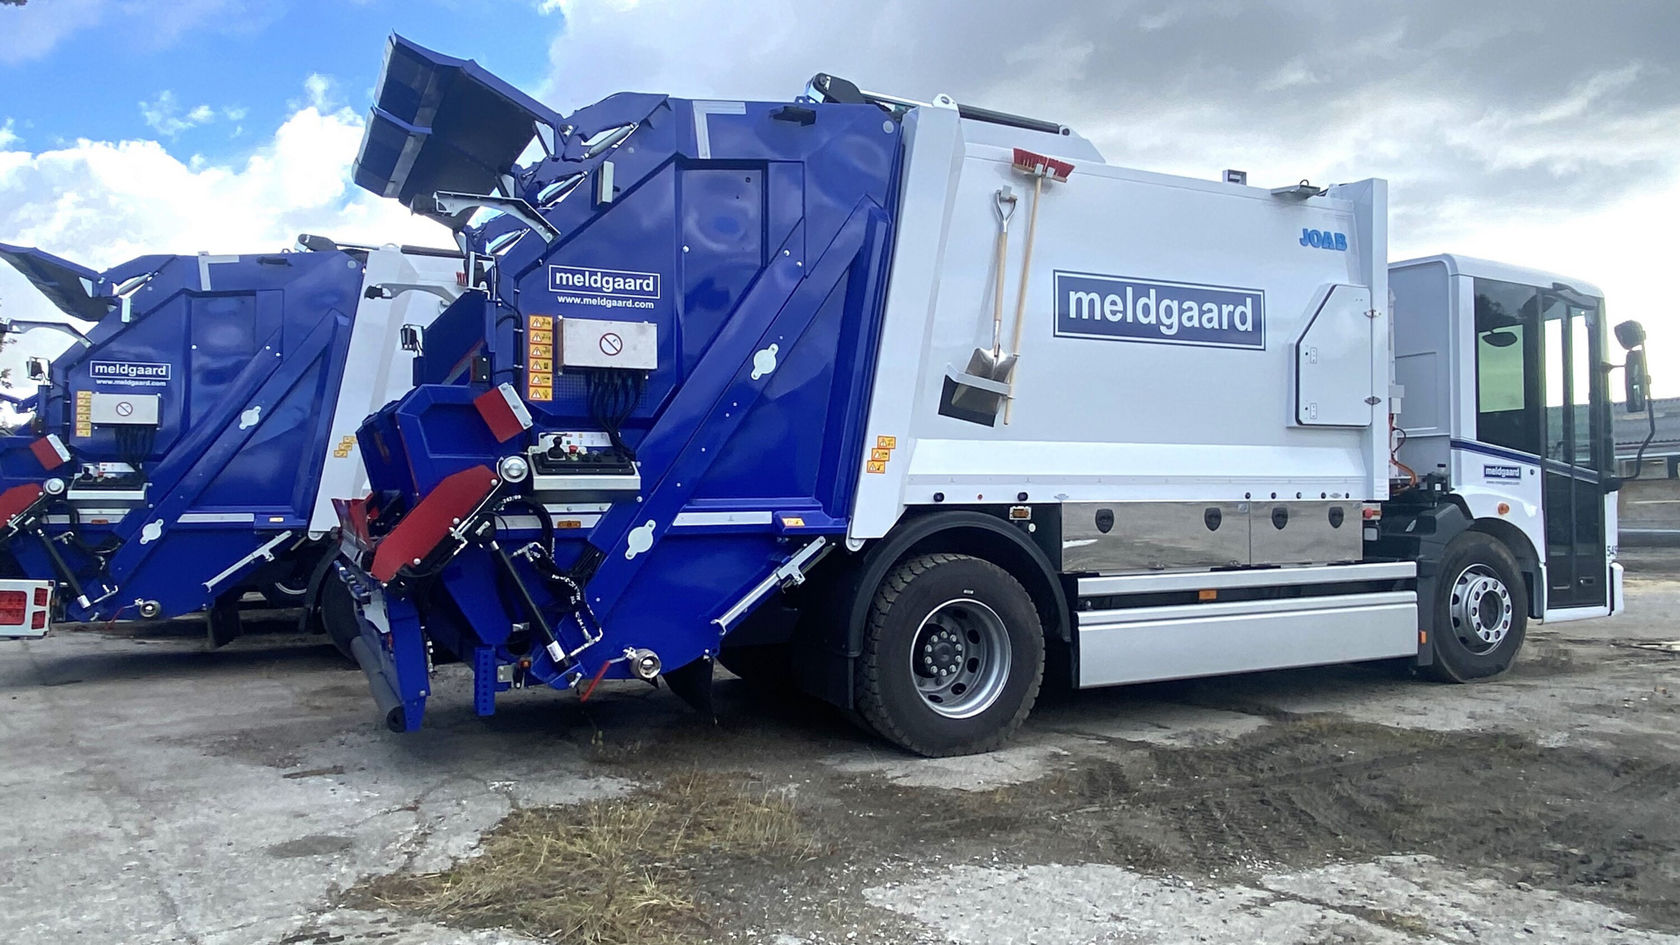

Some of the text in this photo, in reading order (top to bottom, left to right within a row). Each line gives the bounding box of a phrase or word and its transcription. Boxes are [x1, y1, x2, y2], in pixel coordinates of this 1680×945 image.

[1299, 228, 1348, 251] JOAB
[555, 271, 654, 293] meldgaard
[557, 295, 655, 309] www.meldgaard.com
[1068, 286, 1253, 336] meldgaard
[95, 363, 167, 377] meldgaard
[1485, 466, 1520, 478] meldgaard
